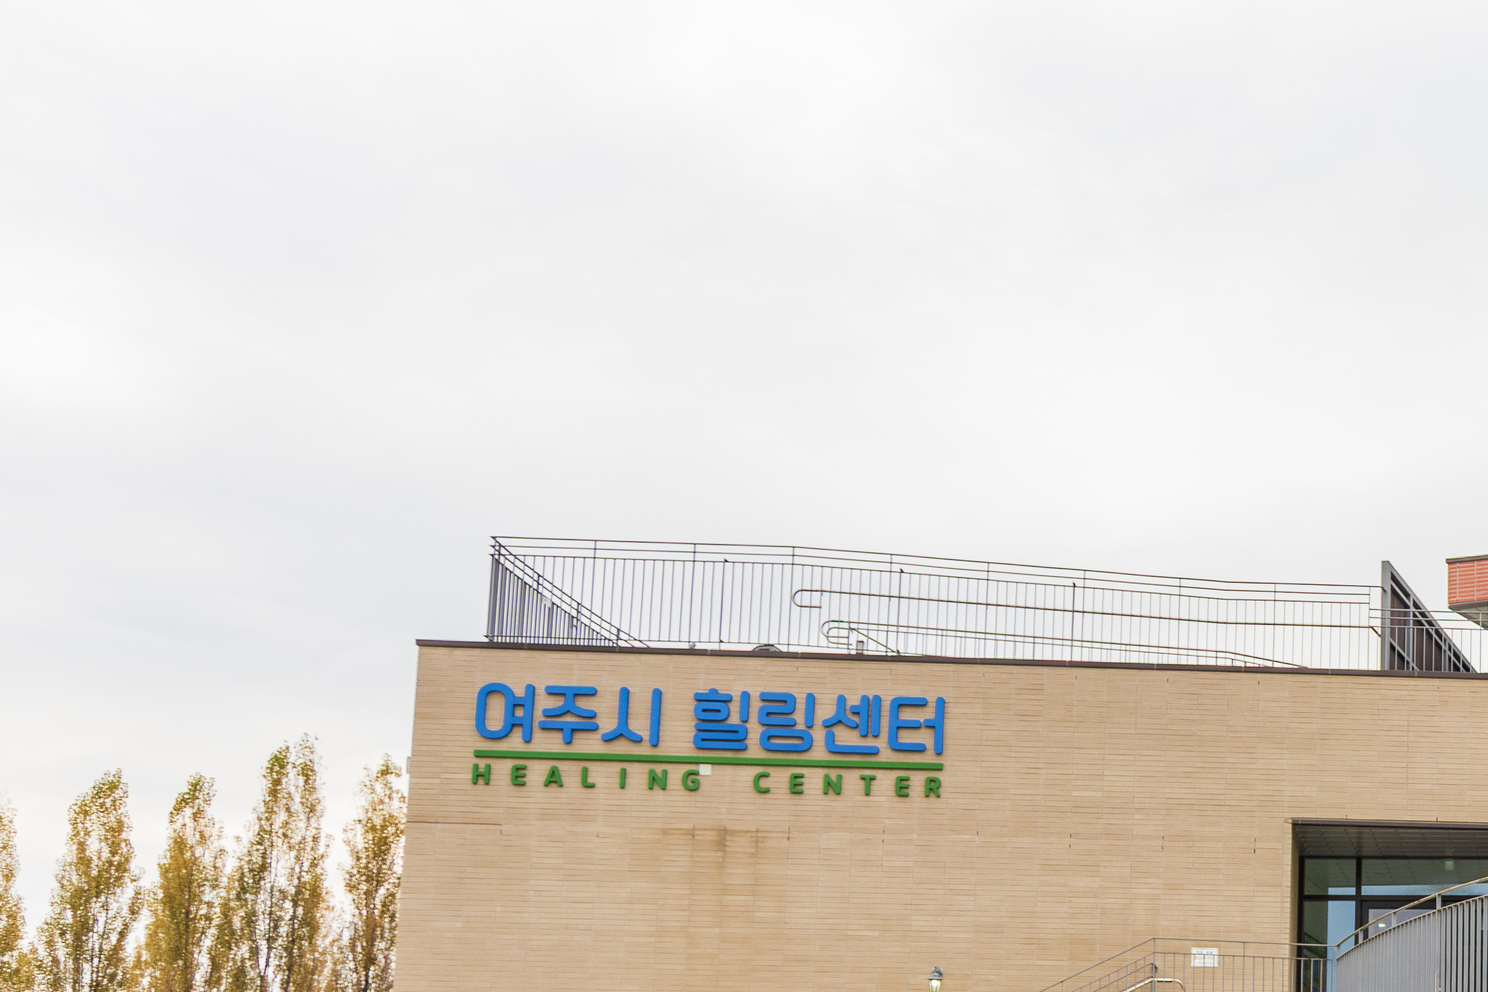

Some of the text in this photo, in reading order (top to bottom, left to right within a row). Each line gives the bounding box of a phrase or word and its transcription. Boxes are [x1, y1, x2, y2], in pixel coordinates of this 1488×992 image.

[474, 682, 946, 755] 여주시 힐링센터
[472, 762, 942, 798] HEALING CENTER
